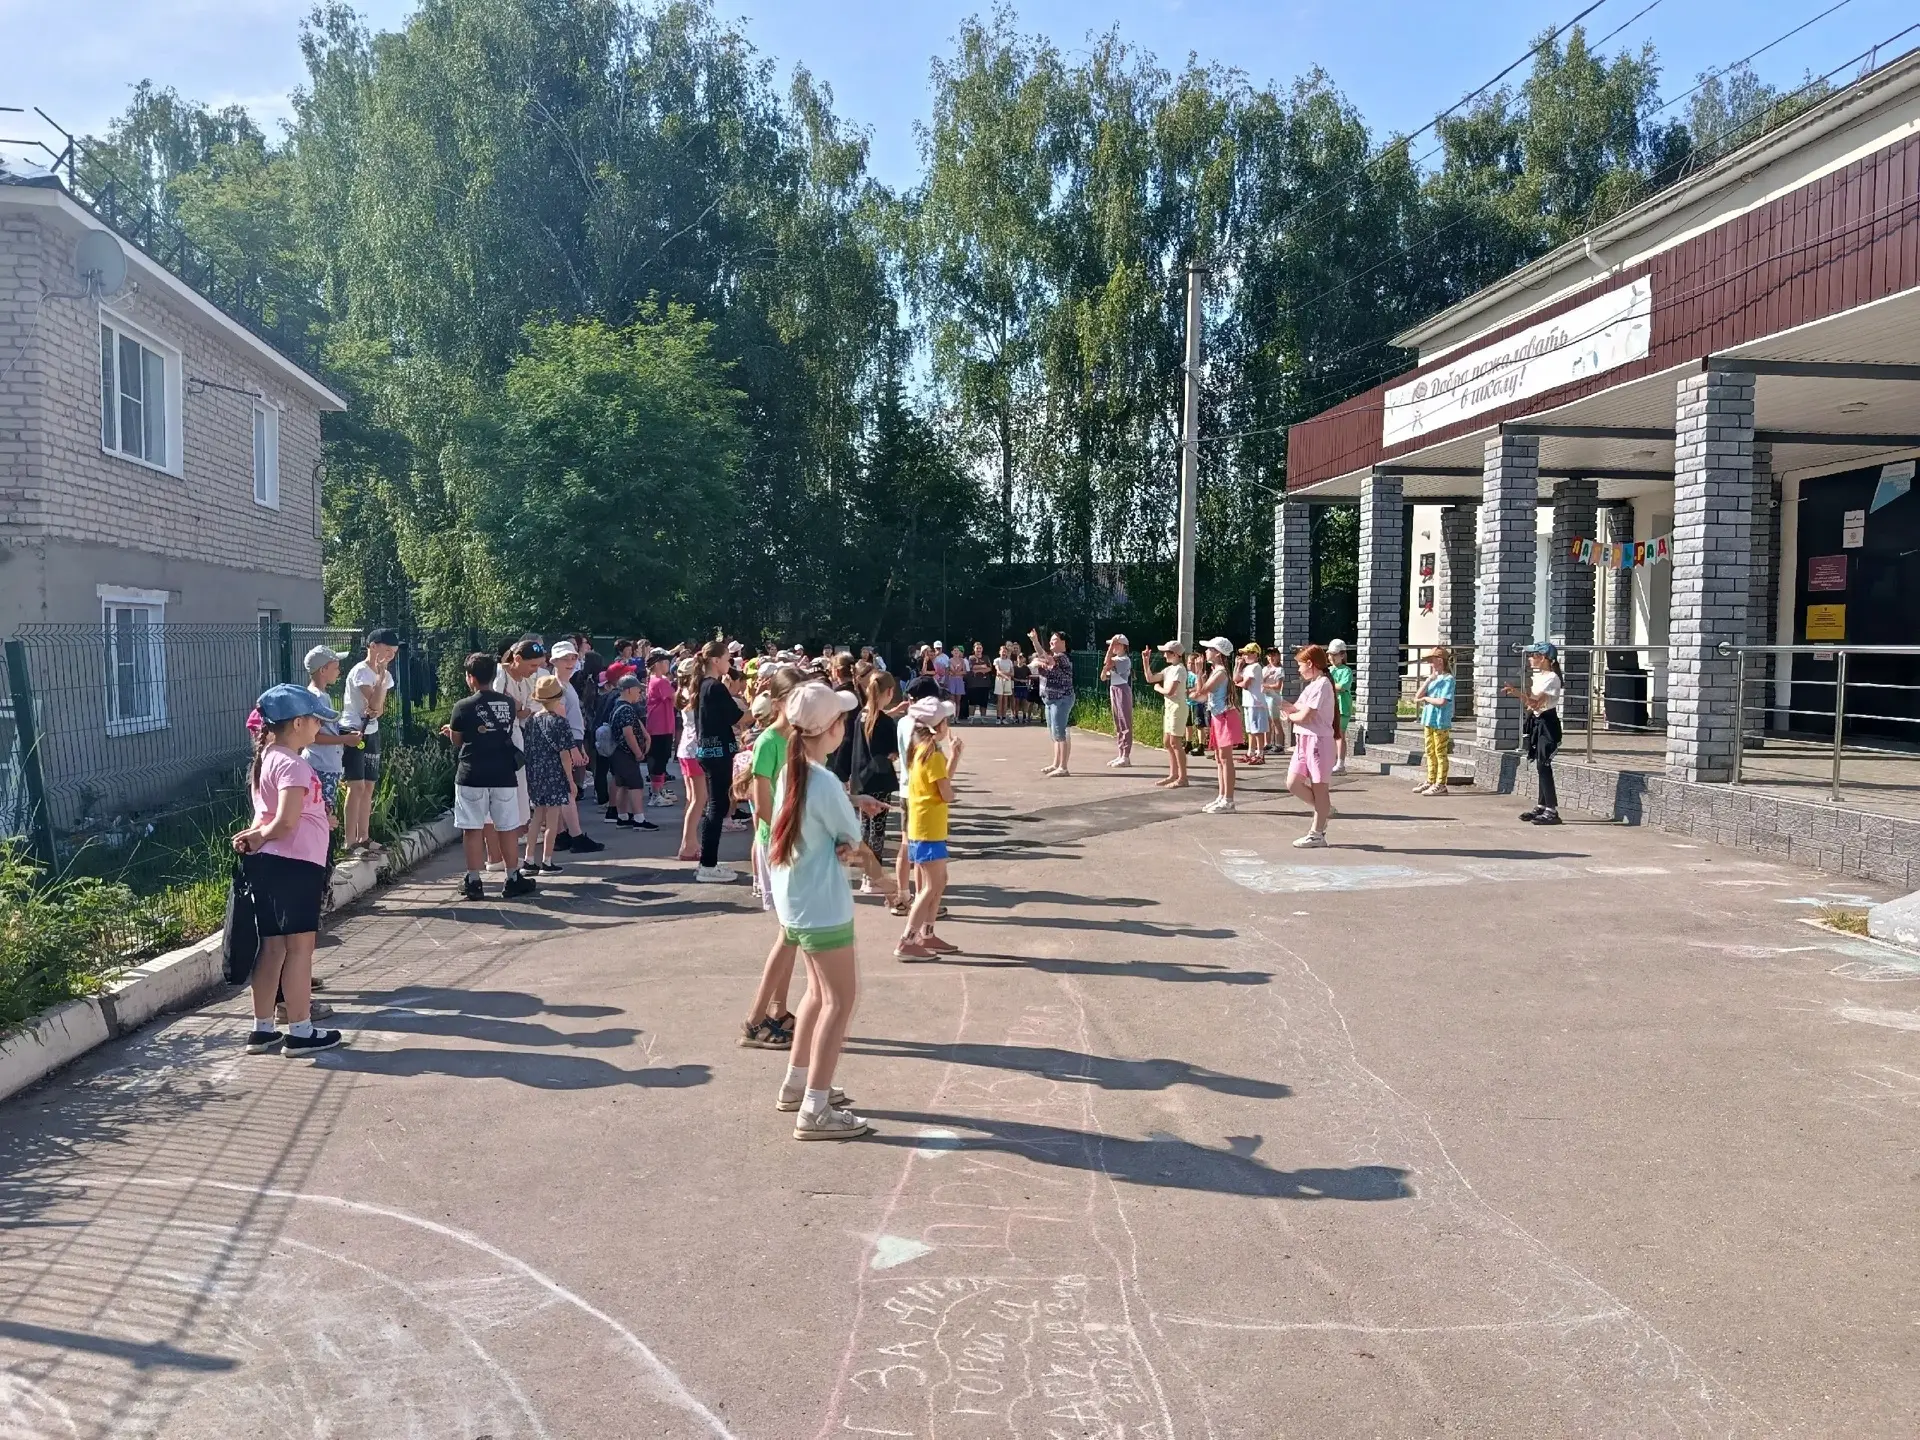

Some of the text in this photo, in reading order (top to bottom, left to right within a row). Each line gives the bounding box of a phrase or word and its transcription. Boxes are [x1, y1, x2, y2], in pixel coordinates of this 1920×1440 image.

[1431, 326, 1569, 398] Добро пожаловать
[1460, 365, 1527, 410] в школу!
[1572, 536, 1674, 561] ЛАГЕРЬ РАД
